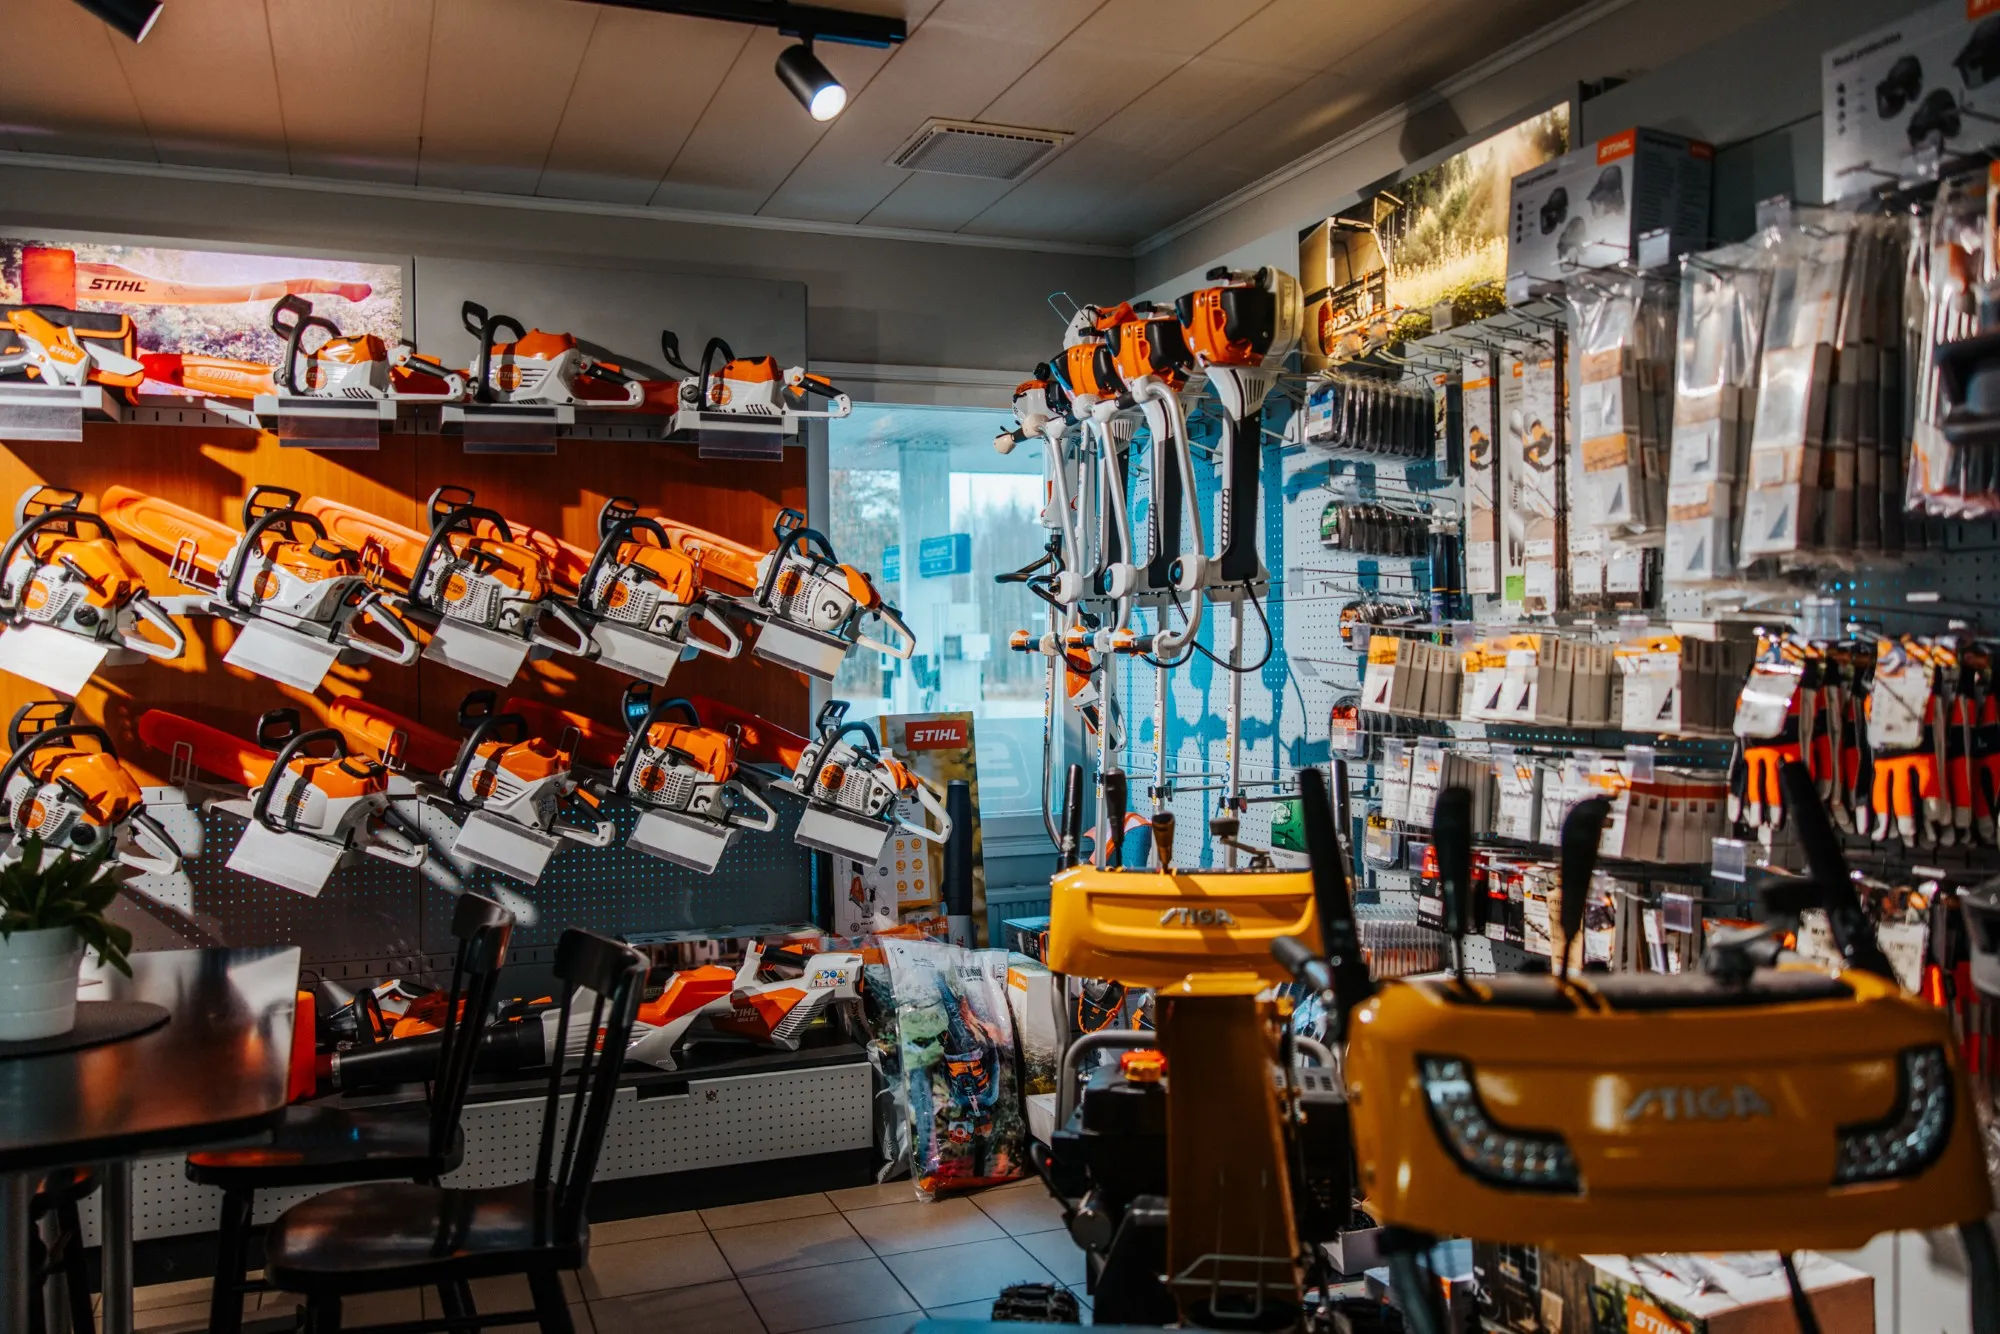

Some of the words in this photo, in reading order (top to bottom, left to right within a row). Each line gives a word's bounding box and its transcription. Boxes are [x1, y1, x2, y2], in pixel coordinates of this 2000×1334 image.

[89, 278, 146, 293] STIHL
[48, 345, 77, 360] STIHL
[913, 729, 960, 742] STIHL
[1160, 907, 1233, 925] STIGA
[1625, 1083, 1772, 1121] STIGA
